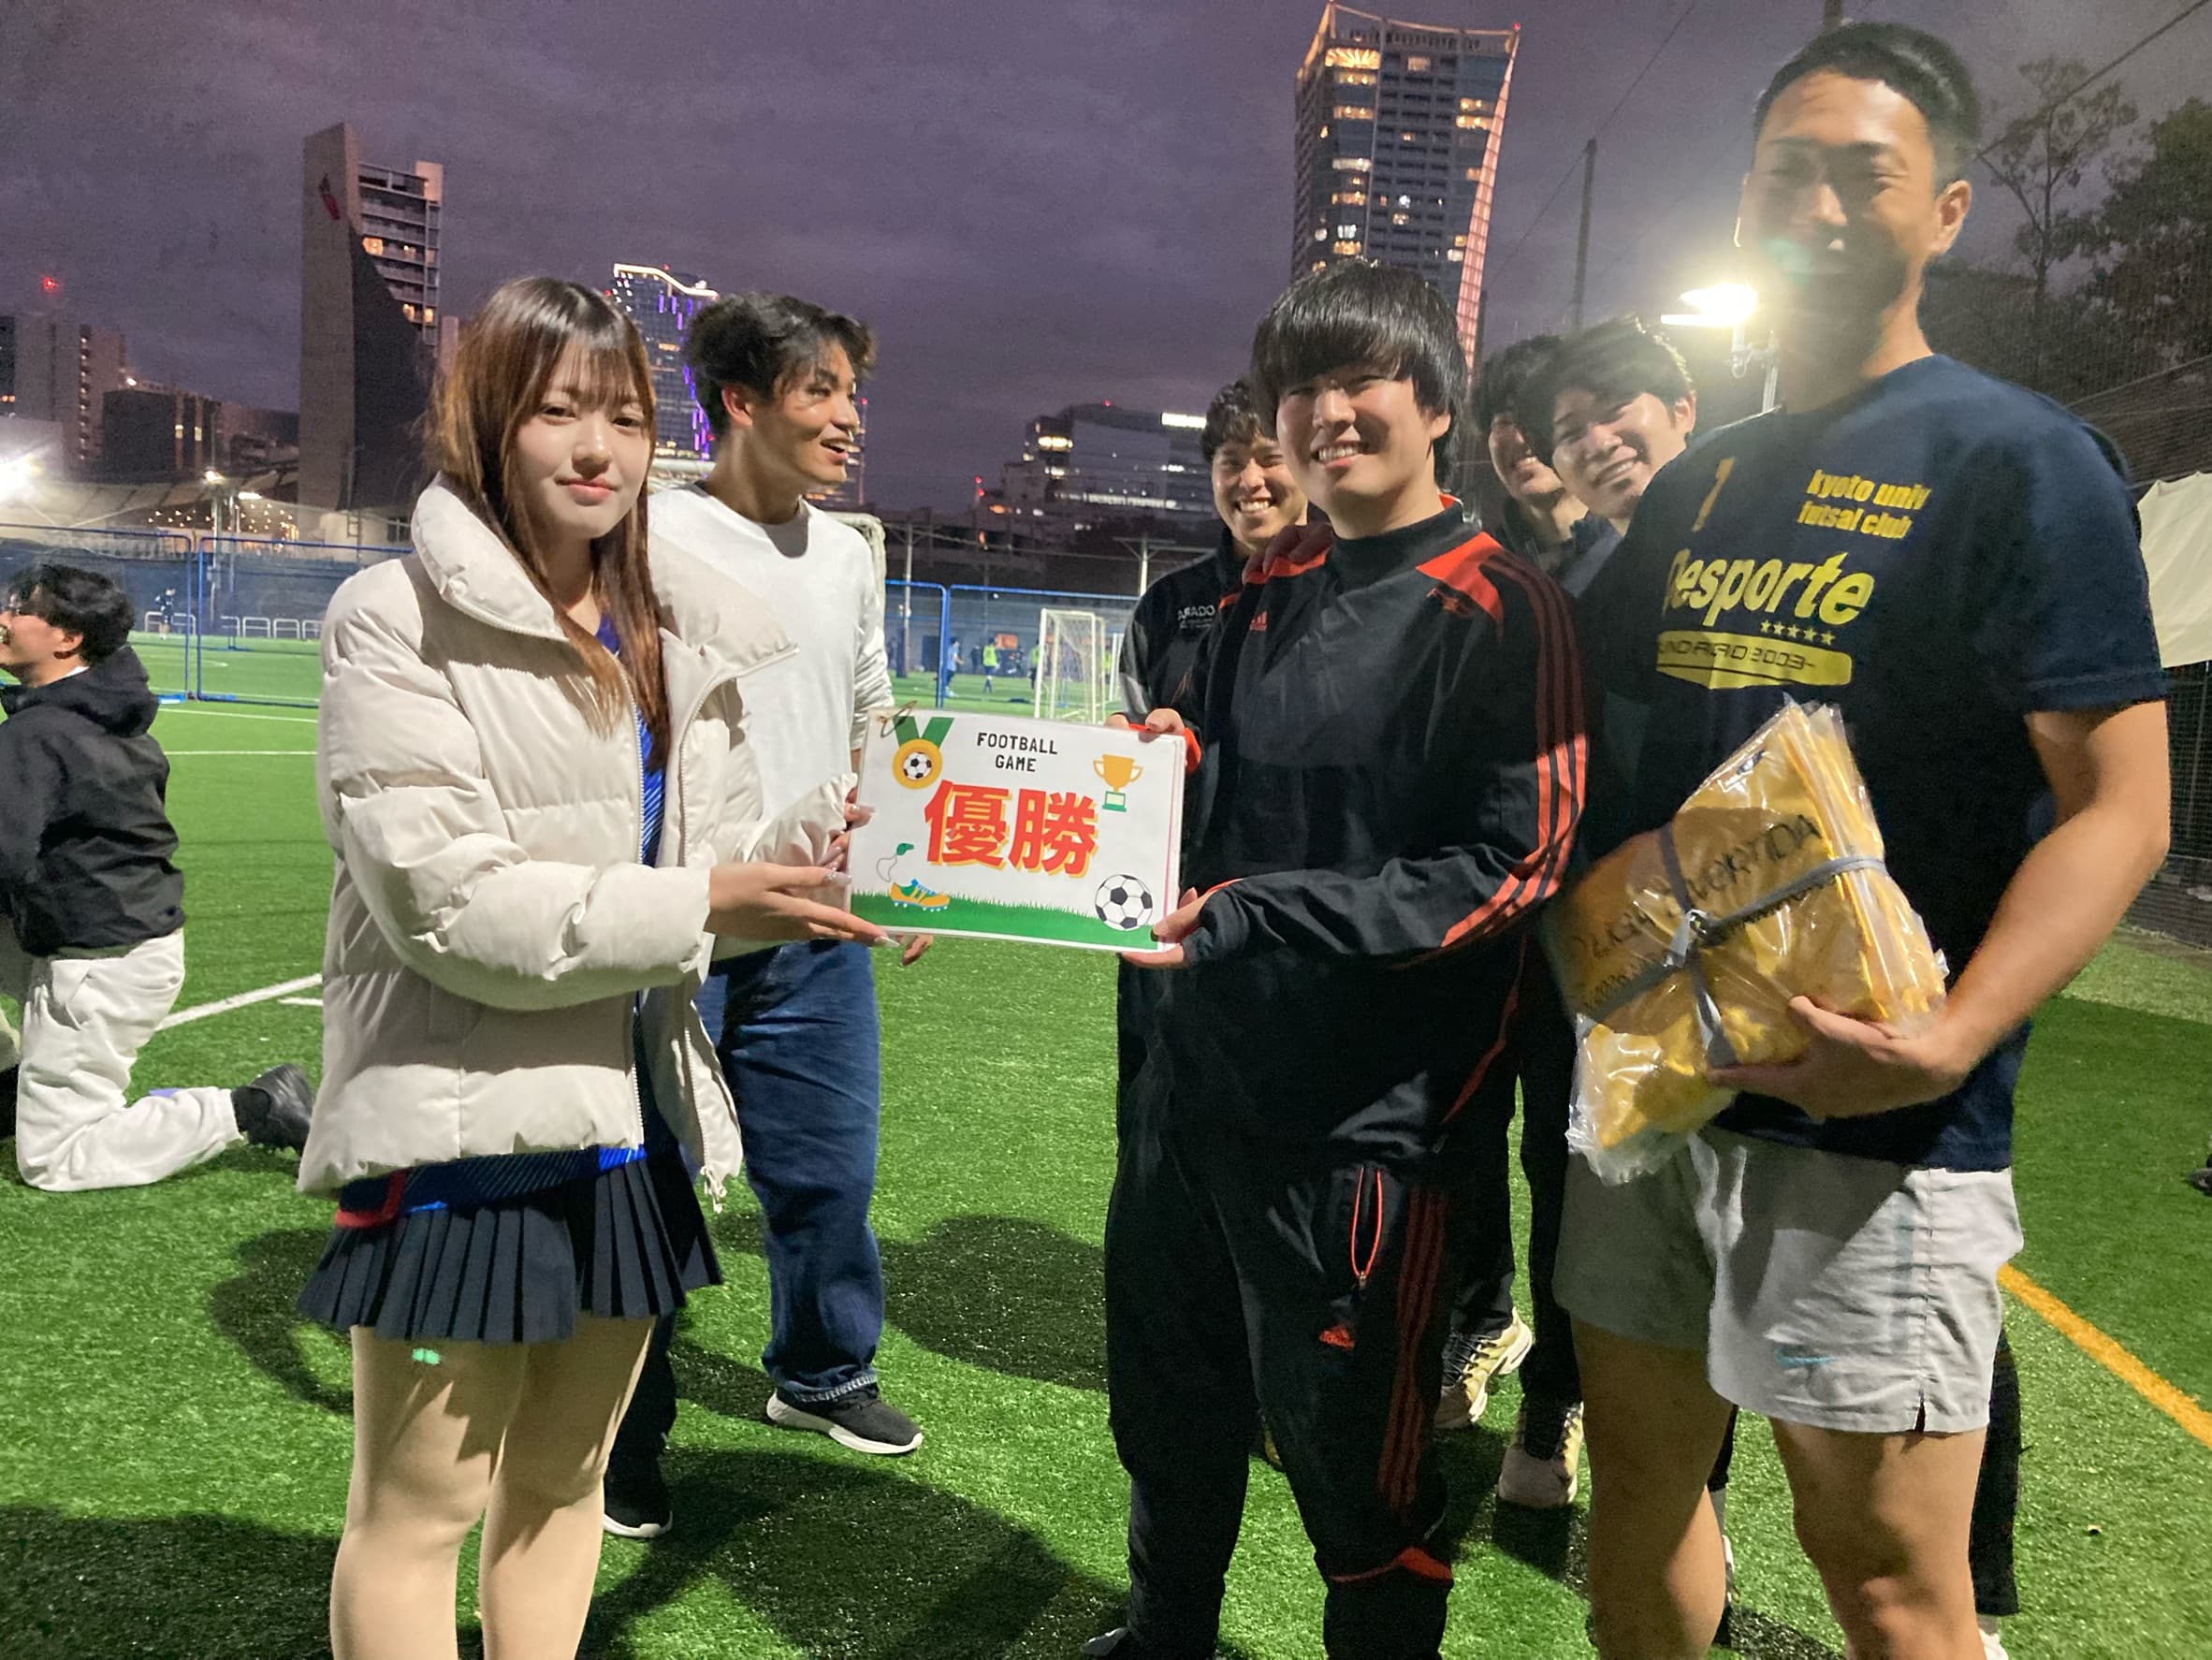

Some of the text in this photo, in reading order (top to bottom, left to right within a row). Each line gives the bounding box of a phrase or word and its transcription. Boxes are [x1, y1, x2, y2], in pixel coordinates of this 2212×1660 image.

[1806, 469, 1932, 510] kyoto univ
[1797, 501, 1913, 539] futsal club
[976, 732, 1058, 755] FOOTBALL
[995, 754, 1037, 773] GAME
[924, 779, 1099, 879] 優勝
